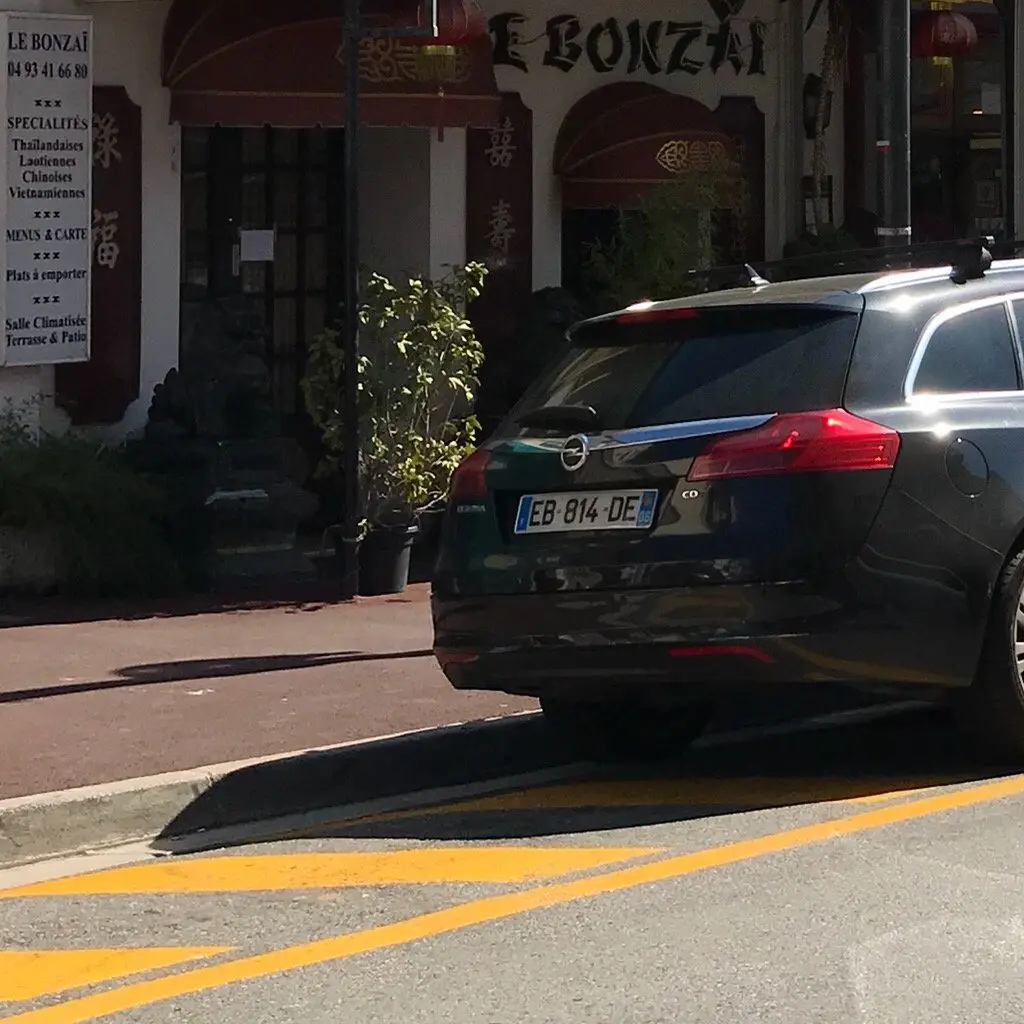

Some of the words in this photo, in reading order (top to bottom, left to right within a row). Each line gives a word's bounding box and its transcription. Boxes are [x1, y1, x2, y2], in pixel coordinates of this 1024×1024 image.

[8, 32, 27, 50] LE
[487, 11, 529, 74] E
[8, 60, 21, 77] 04
[24, 61, 38, 78] 93
[42, 61, 54, 78] 41
[58, 62, 72, 78] 66
[74, 63, 88, 79] 80
[19, 155, 76, 167] Laotiennes
[22, 170, 72, 183] Chinoises
[9, 186, 85, 199] Vietnamiennes
[6, 229, 41, 242] MENUS
[45, 229, 52, 241] &
[55, 228, 87, 241] CARTE
[6, 269, 31, 282] Plats
[33, 268, 39, 280] à
[41, 269, 87, 282] emporter
[6, 317, 30, 330] Salle
[33, 314, 87, 329] Climatisée
[6, 334, 46, 347] Terrasse
[49, 331, 58, 344] &
[62, 330, 87, 344] Patio
